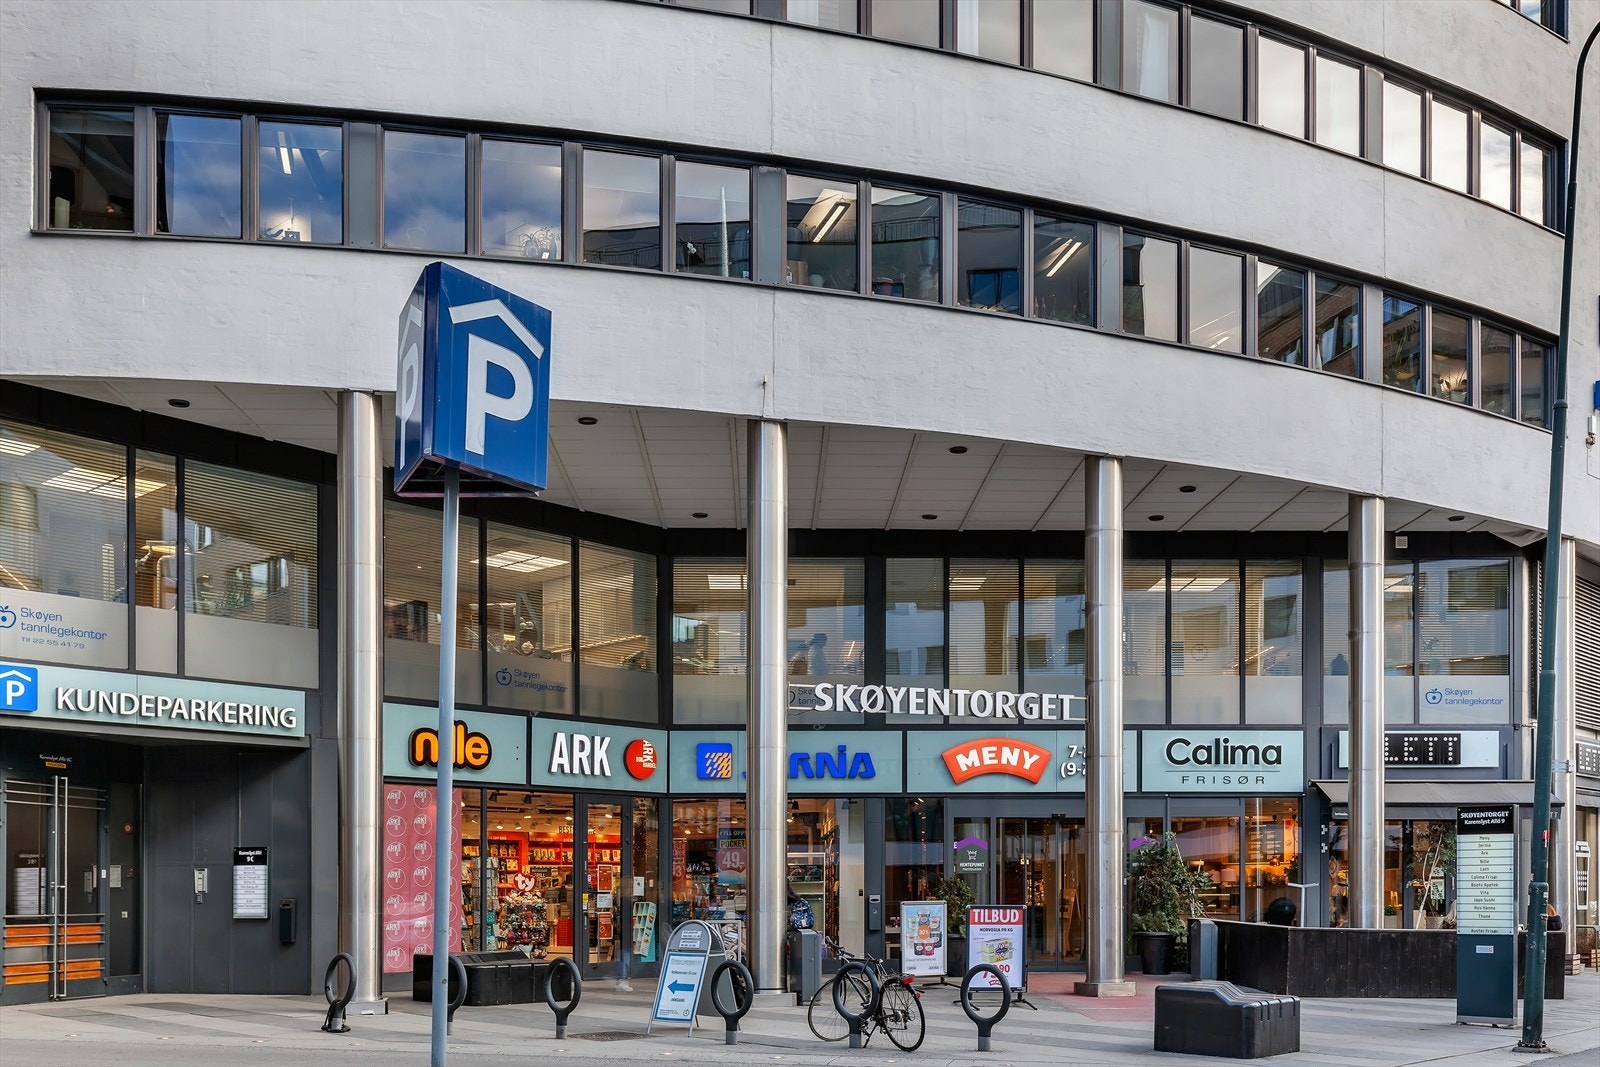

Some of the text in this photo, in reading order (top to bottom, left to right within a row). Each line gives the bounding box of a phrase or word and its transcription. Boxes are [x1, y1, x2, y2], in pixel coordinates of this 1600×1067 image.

[465, 333, 534, 456] P
[20, 607, 63, 623] Skøyen
[20, 622, 107, 640] tannlegekontor
[513, 668, 541, 680] Skøyen
[6, 680, 26, 706] P
[514, 680, 568, 693] tannlegekontor
[1444, 687, 1473, 697] Skøyen
[56, 686, 297, 729] KUNDEPARKERING
[814, 682, 1075, 721] SKØYENTORGET
[1444, 697, 1504, 706] tannlegekontor
[549, 732, 612, 776] ARK
[643, 739, 654, 763] ARK
[955, 745, 1041, 772] MENY
[1165, 737, 1282, 766] Calima
[1384, 736, 1458, 763] LETT
[1181, 775, 1265, 785] FRISØR
[973, 908, 1020, 923] TILBUD
